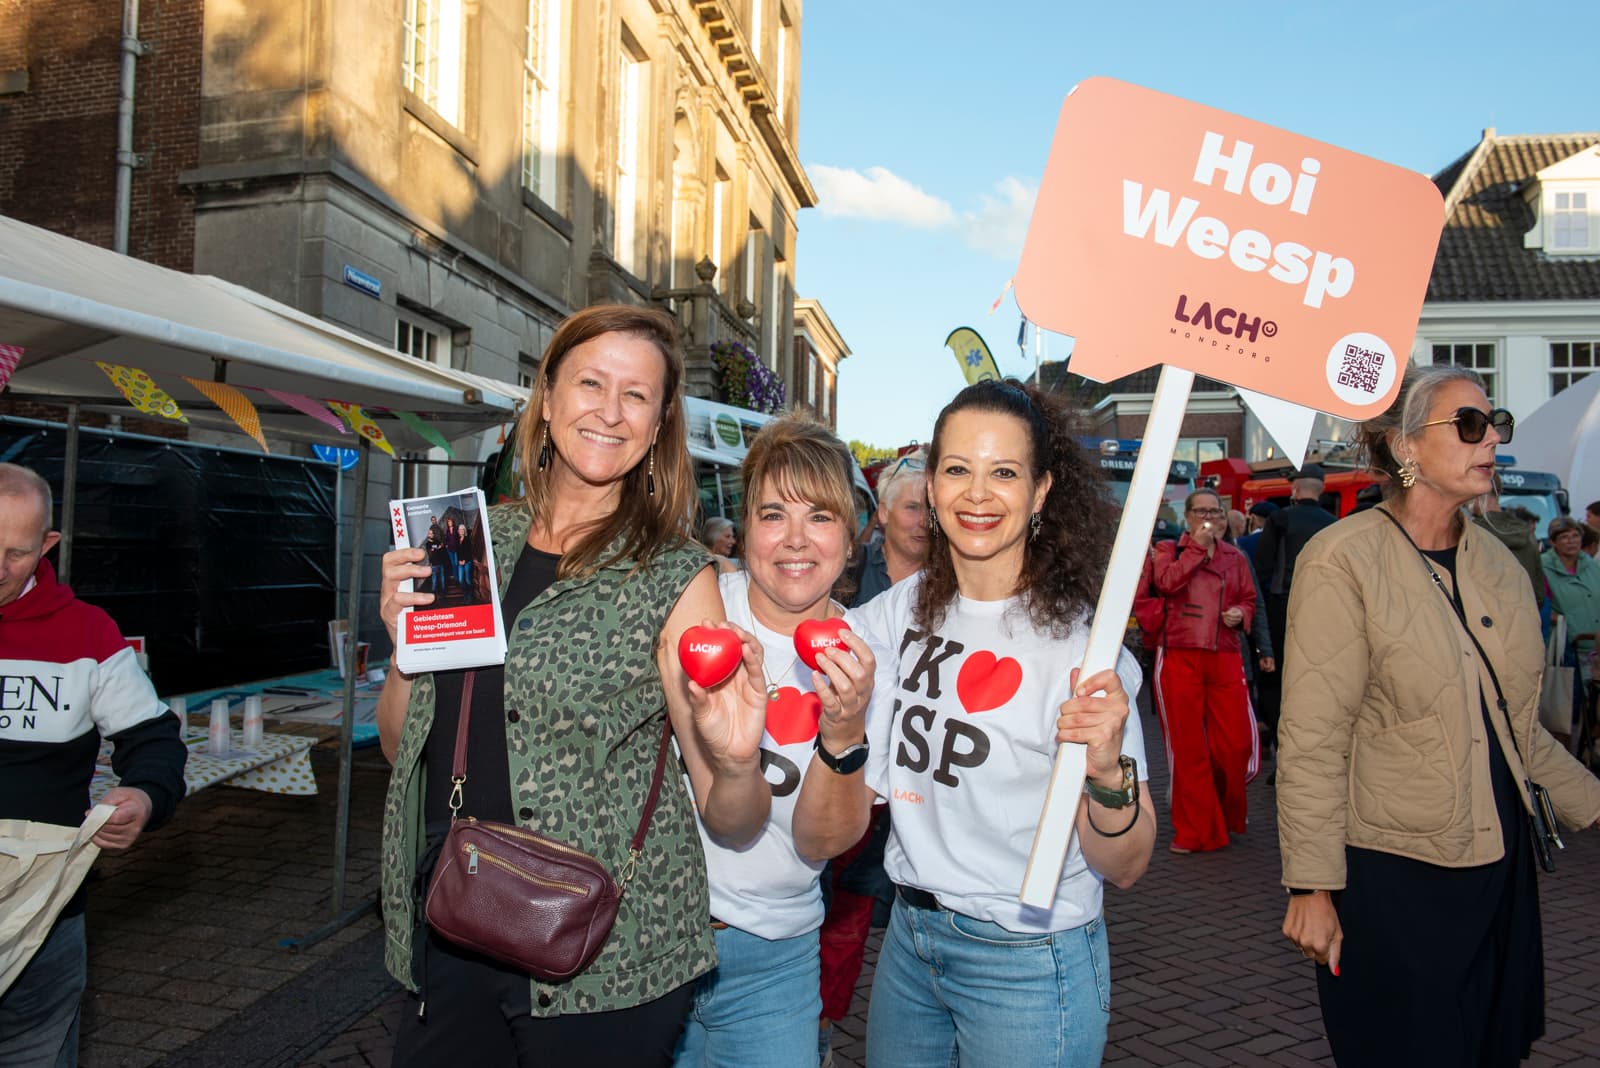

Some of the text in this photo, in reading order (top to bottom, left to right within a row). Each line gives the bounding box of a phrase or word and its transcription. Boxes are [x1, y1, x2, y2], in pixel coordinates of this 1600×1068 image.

[1193, 130, 1321, 216] Hoi
[1123, 178, 1355, 309] Weesp
[1170, 328, 1270, 362] MONDZORG
[413, 613, 454, 622] Gebiedsteam
[413, 620, 467, 632] Weesp-Driemond
